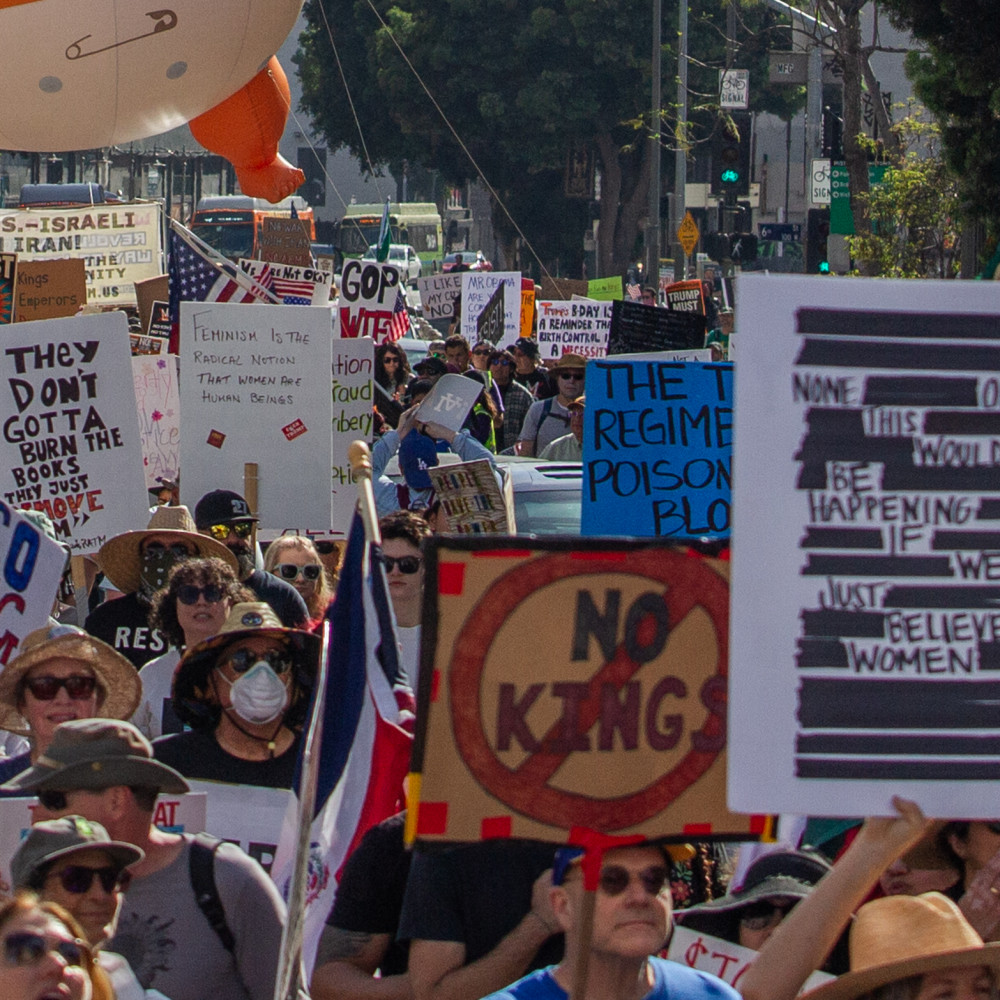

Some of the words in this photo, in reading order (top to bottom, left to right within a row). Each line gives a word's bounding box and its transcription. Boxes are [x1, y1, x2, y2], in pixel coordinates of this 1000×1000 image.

[14, 234, 82, 252] IRAN!
[17, 271, 49, 288] Kings
[341, 261, 399, 304] GOP
[434, 276, 462, 290] LIKE
[18, 293, 78, 309] Emperors
[571, 304, 600, 318] B-DAY
[667, 289, 700, 303] TRUMP
[672, 301, 699, 312] MUST
[539, 319, 546, 330] A
[549, 319, 593, 331] REMINDER
[595, 319, 611, 330] THA
[539, 332, 561, 343] BIRTH
[562, 332, 600, 343] CONTROL
[550, 345, 558, 357] A
[8, 368, 98, 414] DON'T
[595, 363, 687, 402] THE
[791, 372, 859, 403] NONE
[3, 405, 107, 443] GOTTA
[594, 403, 734, 451] REGIME
[863, 408, 917, 434] THIS
[19, 434, 79, 466] BURN
[84, 427, 124, 452] THE
[11, 456, 81, 488] BOOKS
[587, 456, 733, 503] POISON
[831, 461, 873, 496] BE
[4, 483, 43, 505] THEY
[48, 473, 90, 497] JUST
[12, 488, 105, 520] EMOVE
[808, 489, 973, 526] HAPPENING
[888, 524, 925, 556] IF
[957, 550, 1000, 581] WE
[818, 576, 889, 611] JUST
[571, 588, 670, 664] NO
[886, 611, 1000, 644] BELIEVE
[849, 640, 973, 674] WOMEN
[496, 676, 728, 753] KINGS
